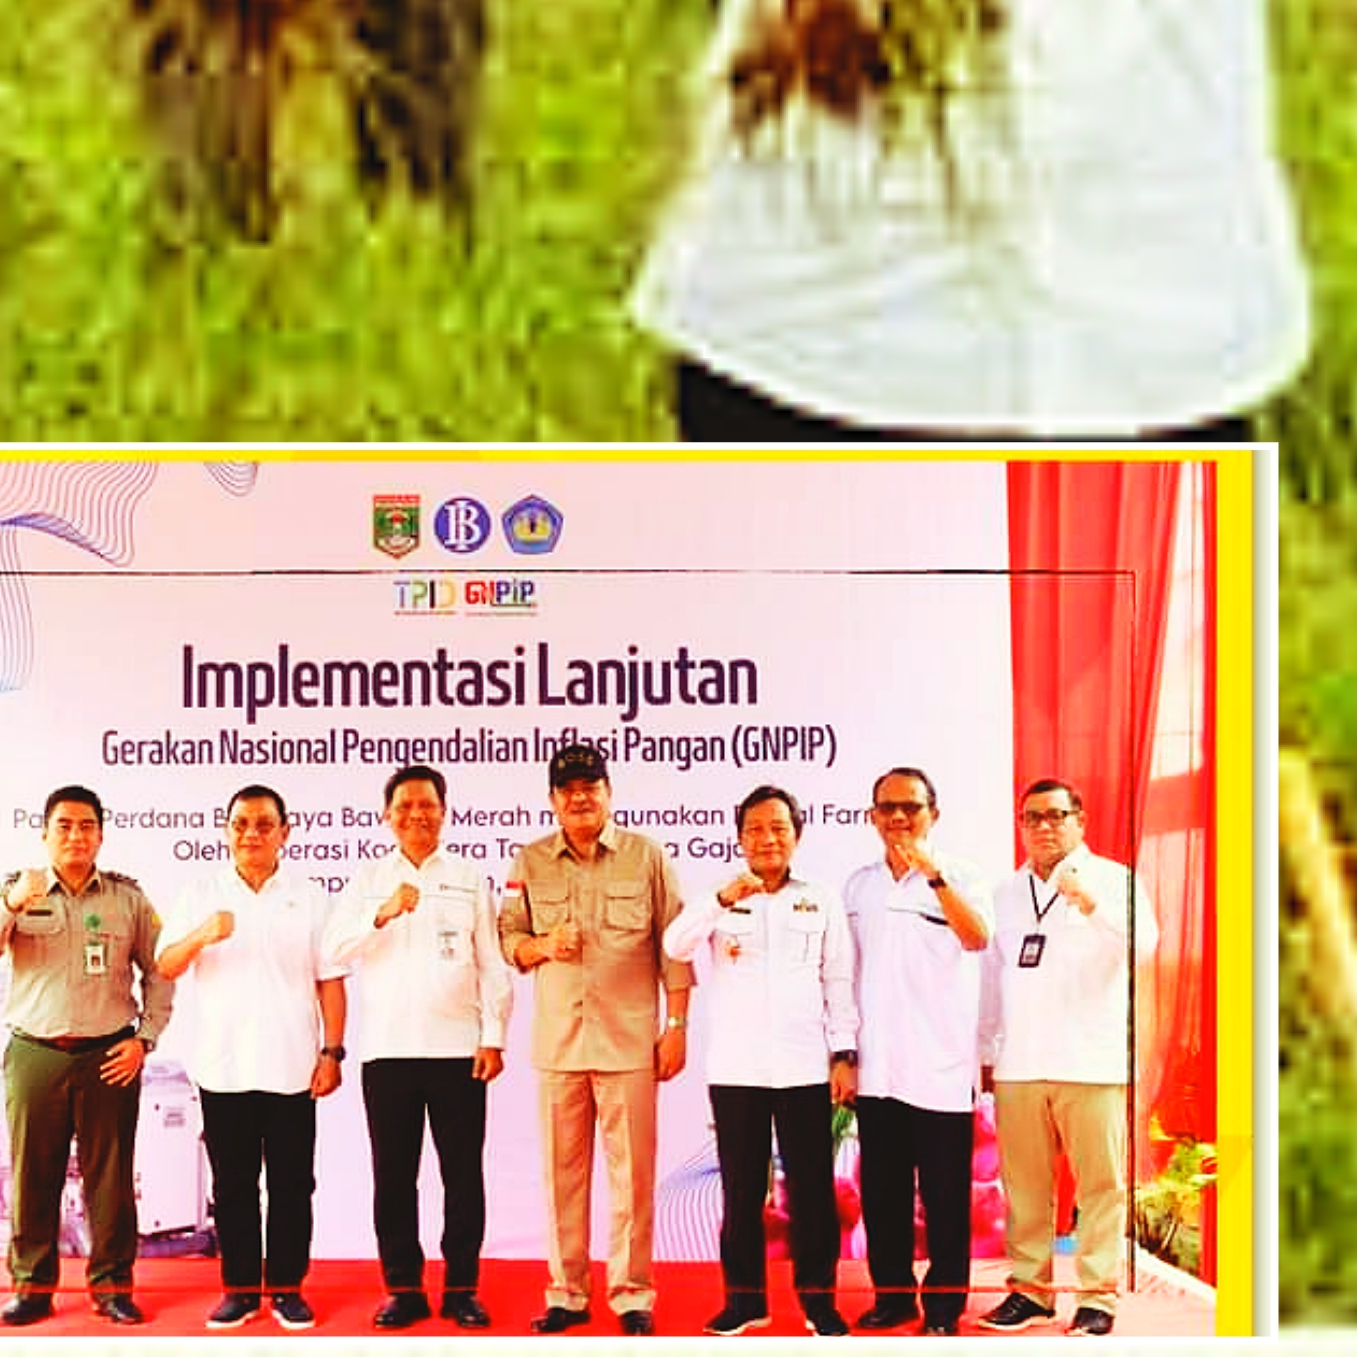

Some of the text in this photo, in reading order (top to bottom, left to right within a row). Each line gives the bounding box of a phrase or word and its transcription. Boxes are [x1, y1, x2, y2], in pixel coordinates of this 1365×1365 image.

[183, 642, 758, 724] Implementasi Lanjutan
[102, 729, 213, 765] Gerakan
[219, 728, 336, 765] Nasional
[342, 726, 528, 769] Pengendalian
[624, 726, 725, 771] Pangan
[732, 724, 837, 768] (GNPIP)
[102, 807, 205, 829] Perdana
[451, 806, 531, 827] Merah
[173, 840, 230, 861] Oleh
